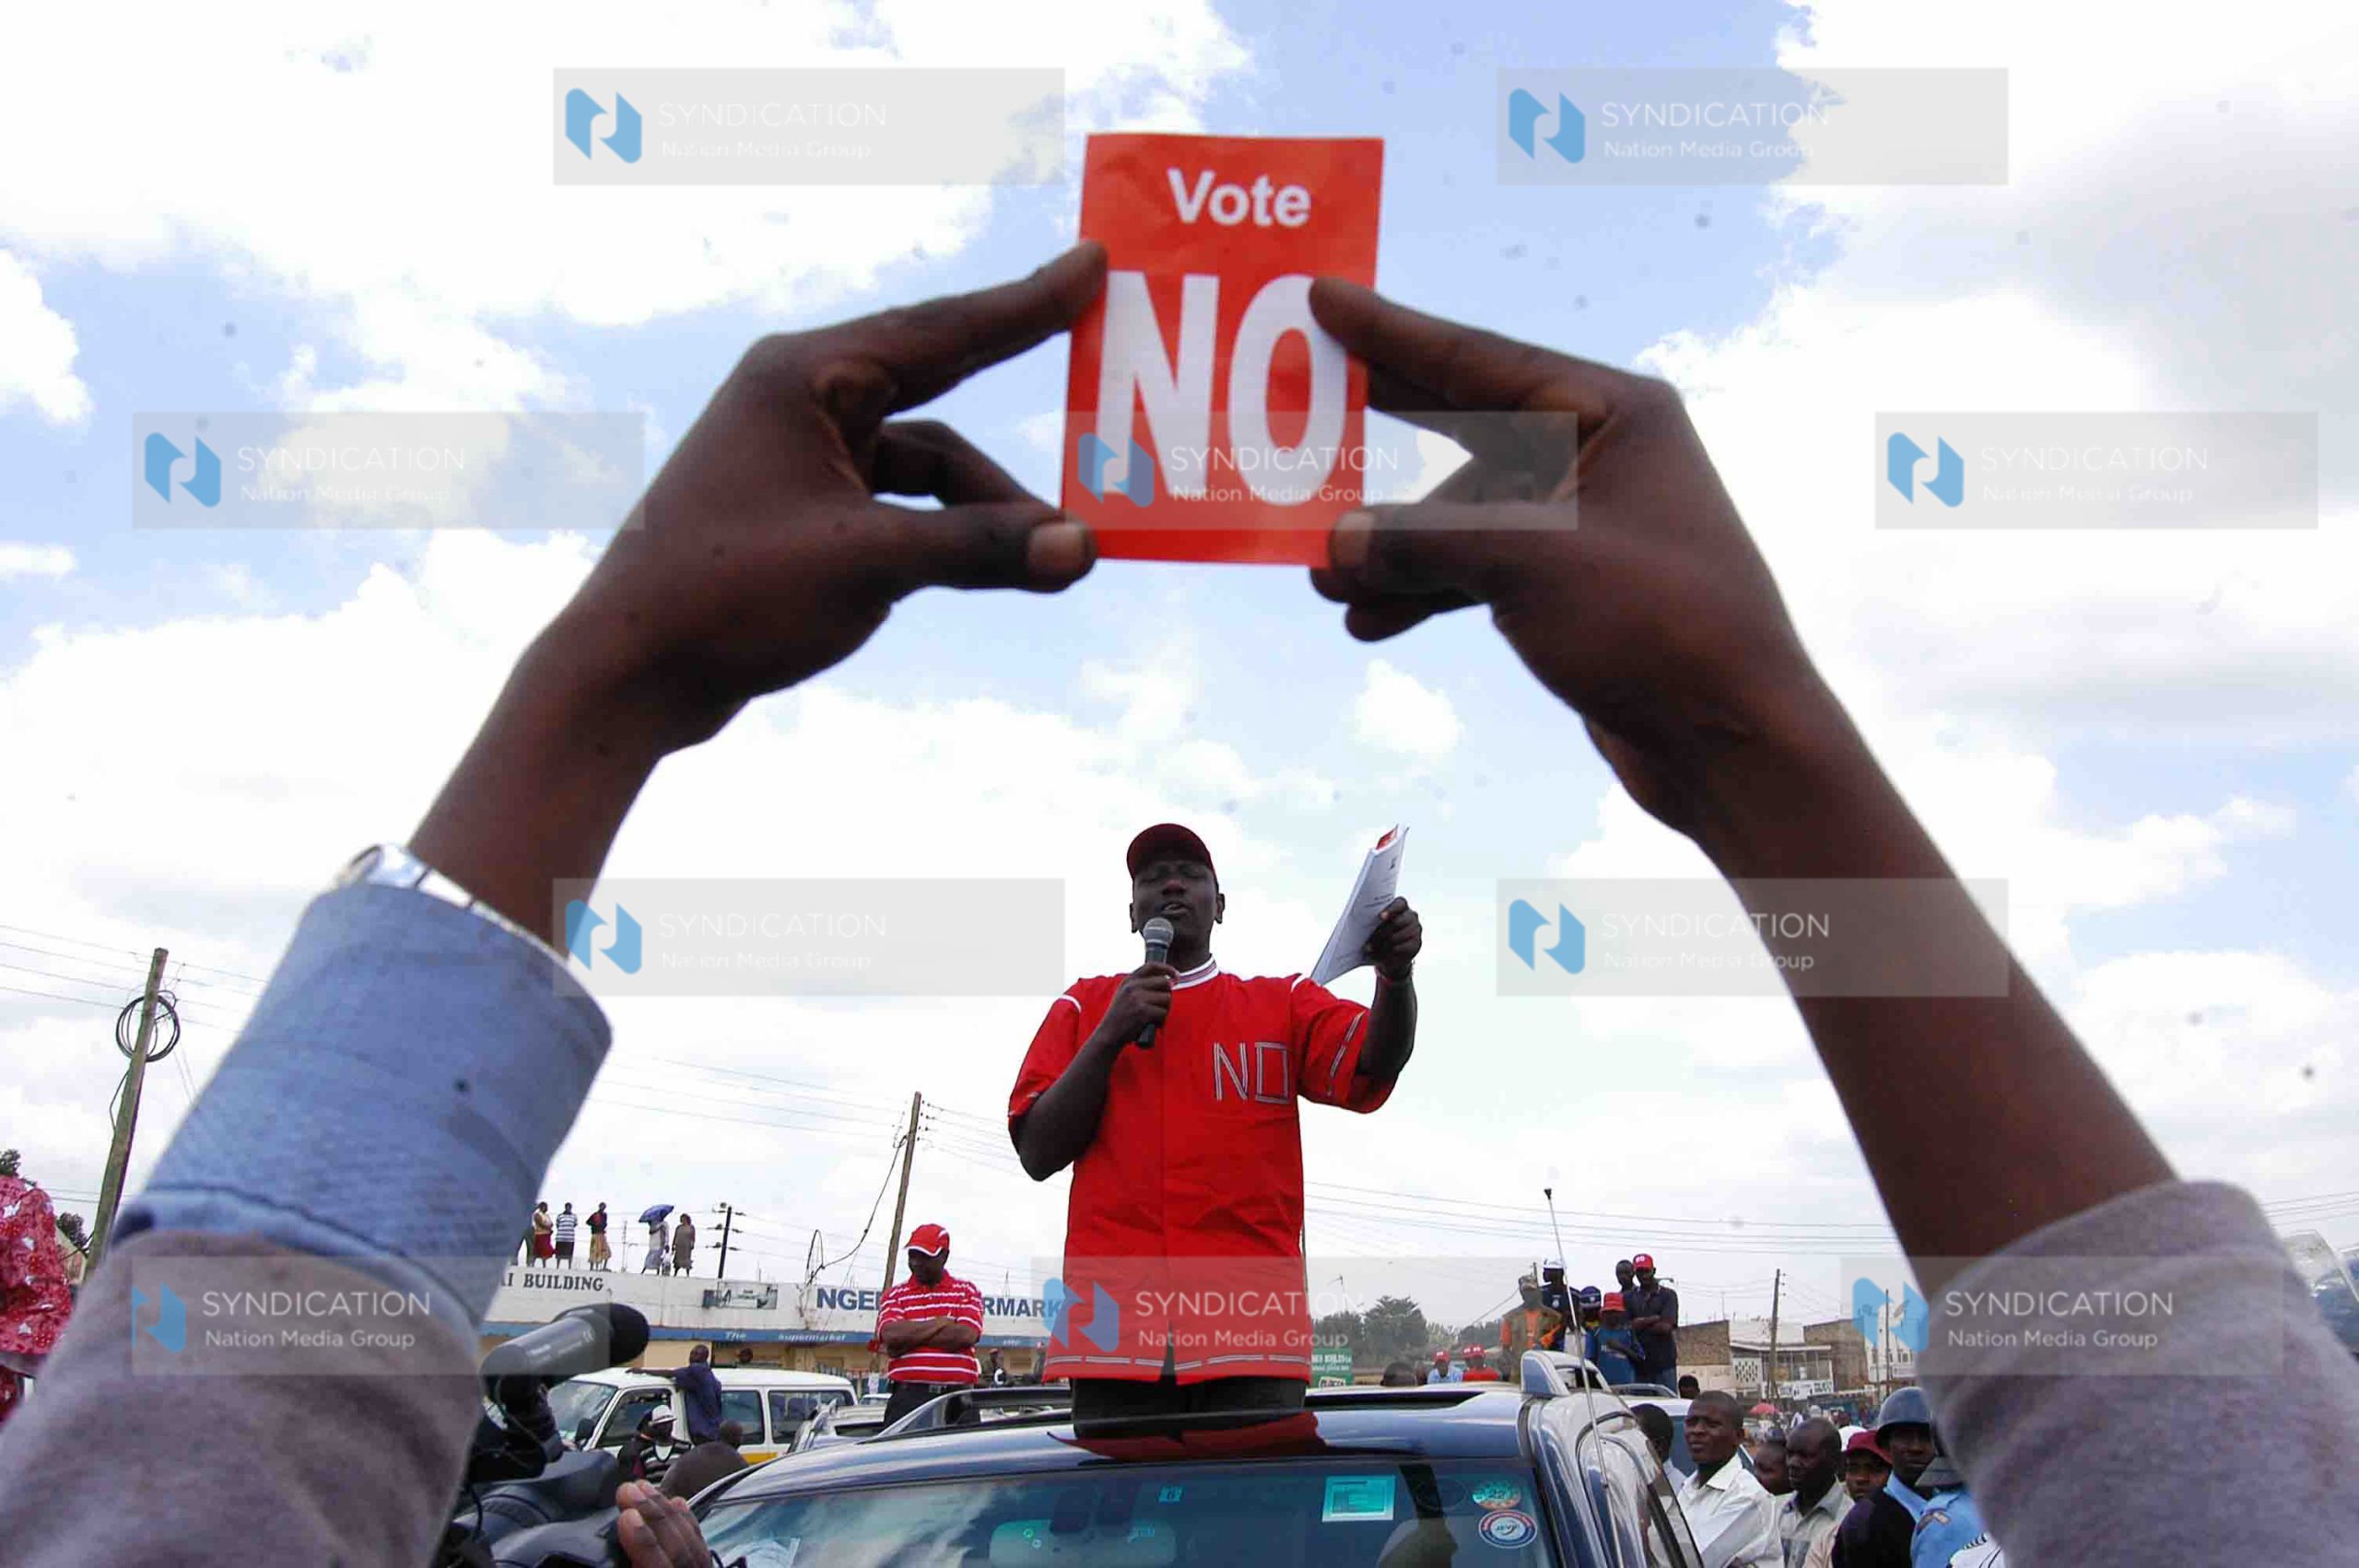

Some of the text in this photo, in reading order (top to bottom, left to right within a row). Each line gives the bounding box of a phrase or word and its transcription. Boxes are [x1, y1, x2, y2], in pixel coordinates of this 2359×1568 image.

[1167, 168, 1311, 227] Vote
[1094, 270, 1348, 506] NO
[1213, 1041, 1291, 1105] NO
[523, 1273, 604, 1291] BUILDING
